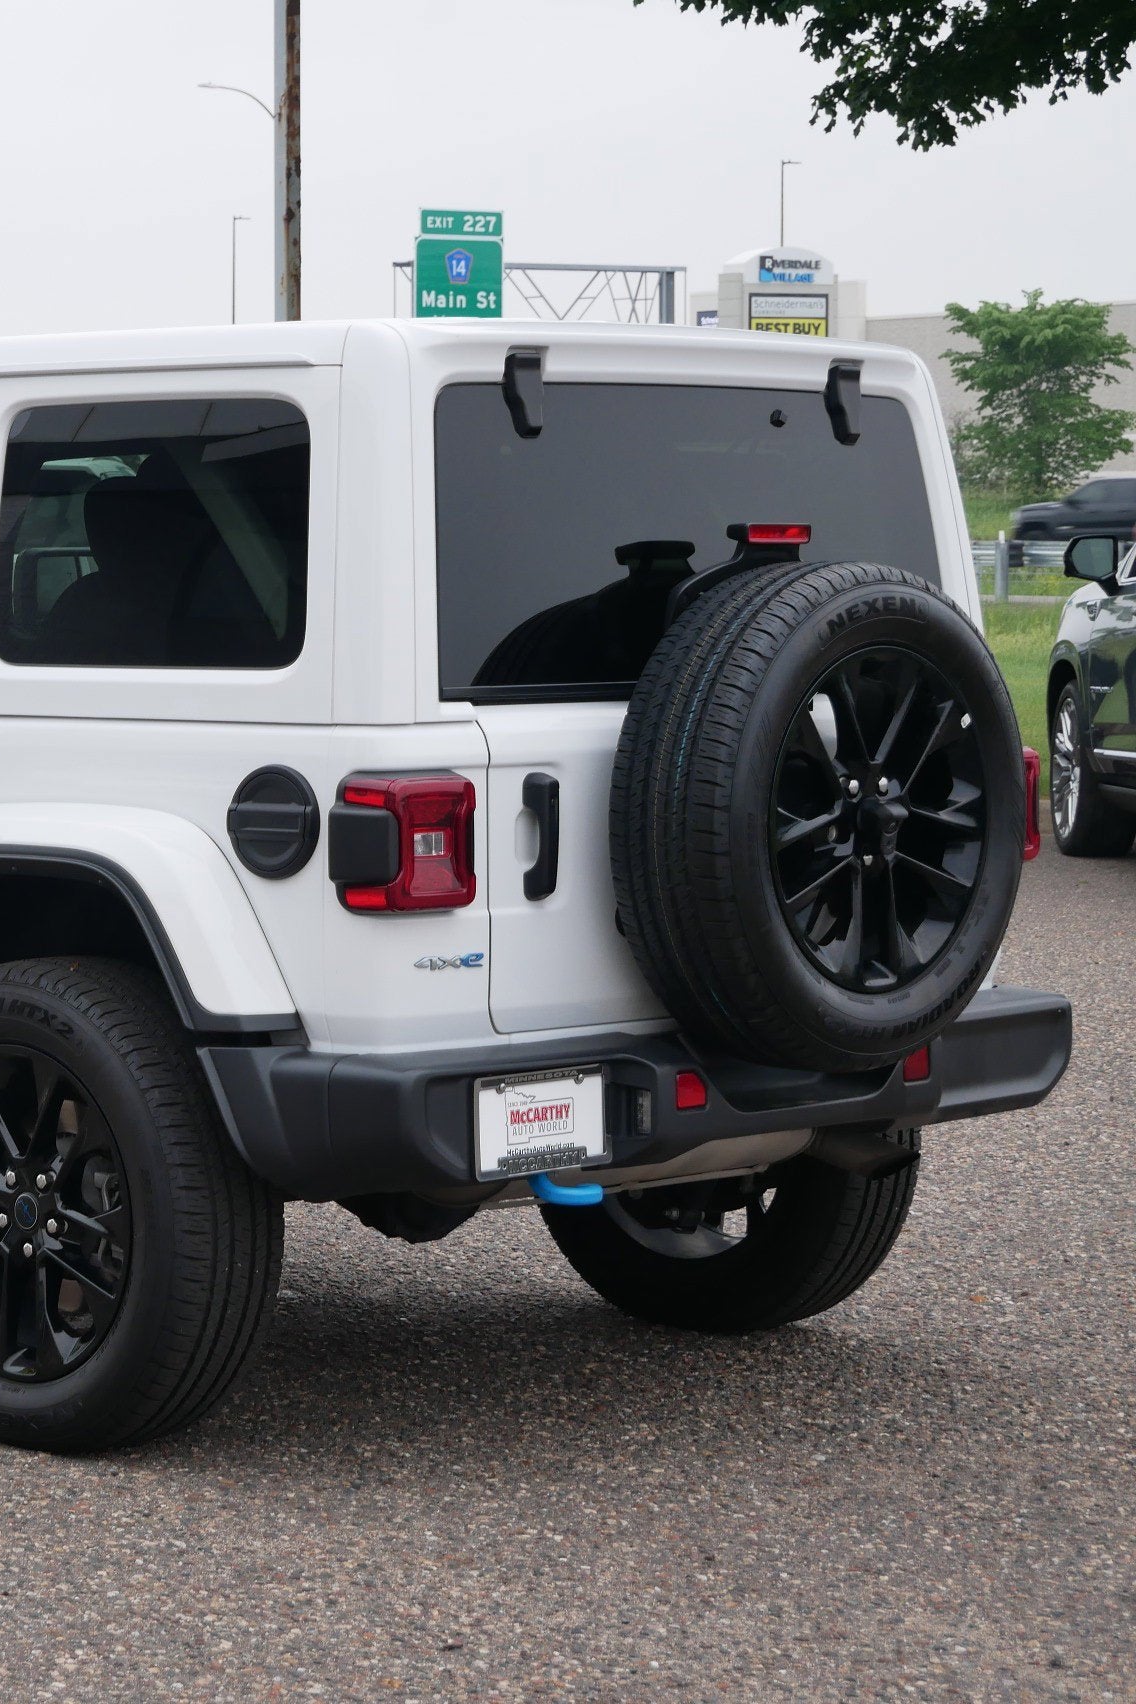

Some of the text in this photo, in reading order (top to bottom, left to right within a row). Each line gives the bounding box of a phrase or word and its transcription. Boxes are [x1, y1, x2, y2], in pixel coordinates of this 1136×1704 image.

[426, 214, 497, 233] EXIT 227
[451, 259, 466, 277] 14
[763, 257, 821, 271] RIVERDALE
[773, 272, 813, 284] VILLAGE
[421, 289, 497, 309] Main St
[753, 299, 824, 310] Schneiderman's
[792, 322, 822, 336] BUY
[827, 596, 916, 637] NEXEN
[504, 1069, 579, 1084] MINNESOTA
[509, 1103, 571, 1124] McCARTHY
[512, 1120, 568, 1137] AUTO WORLD
